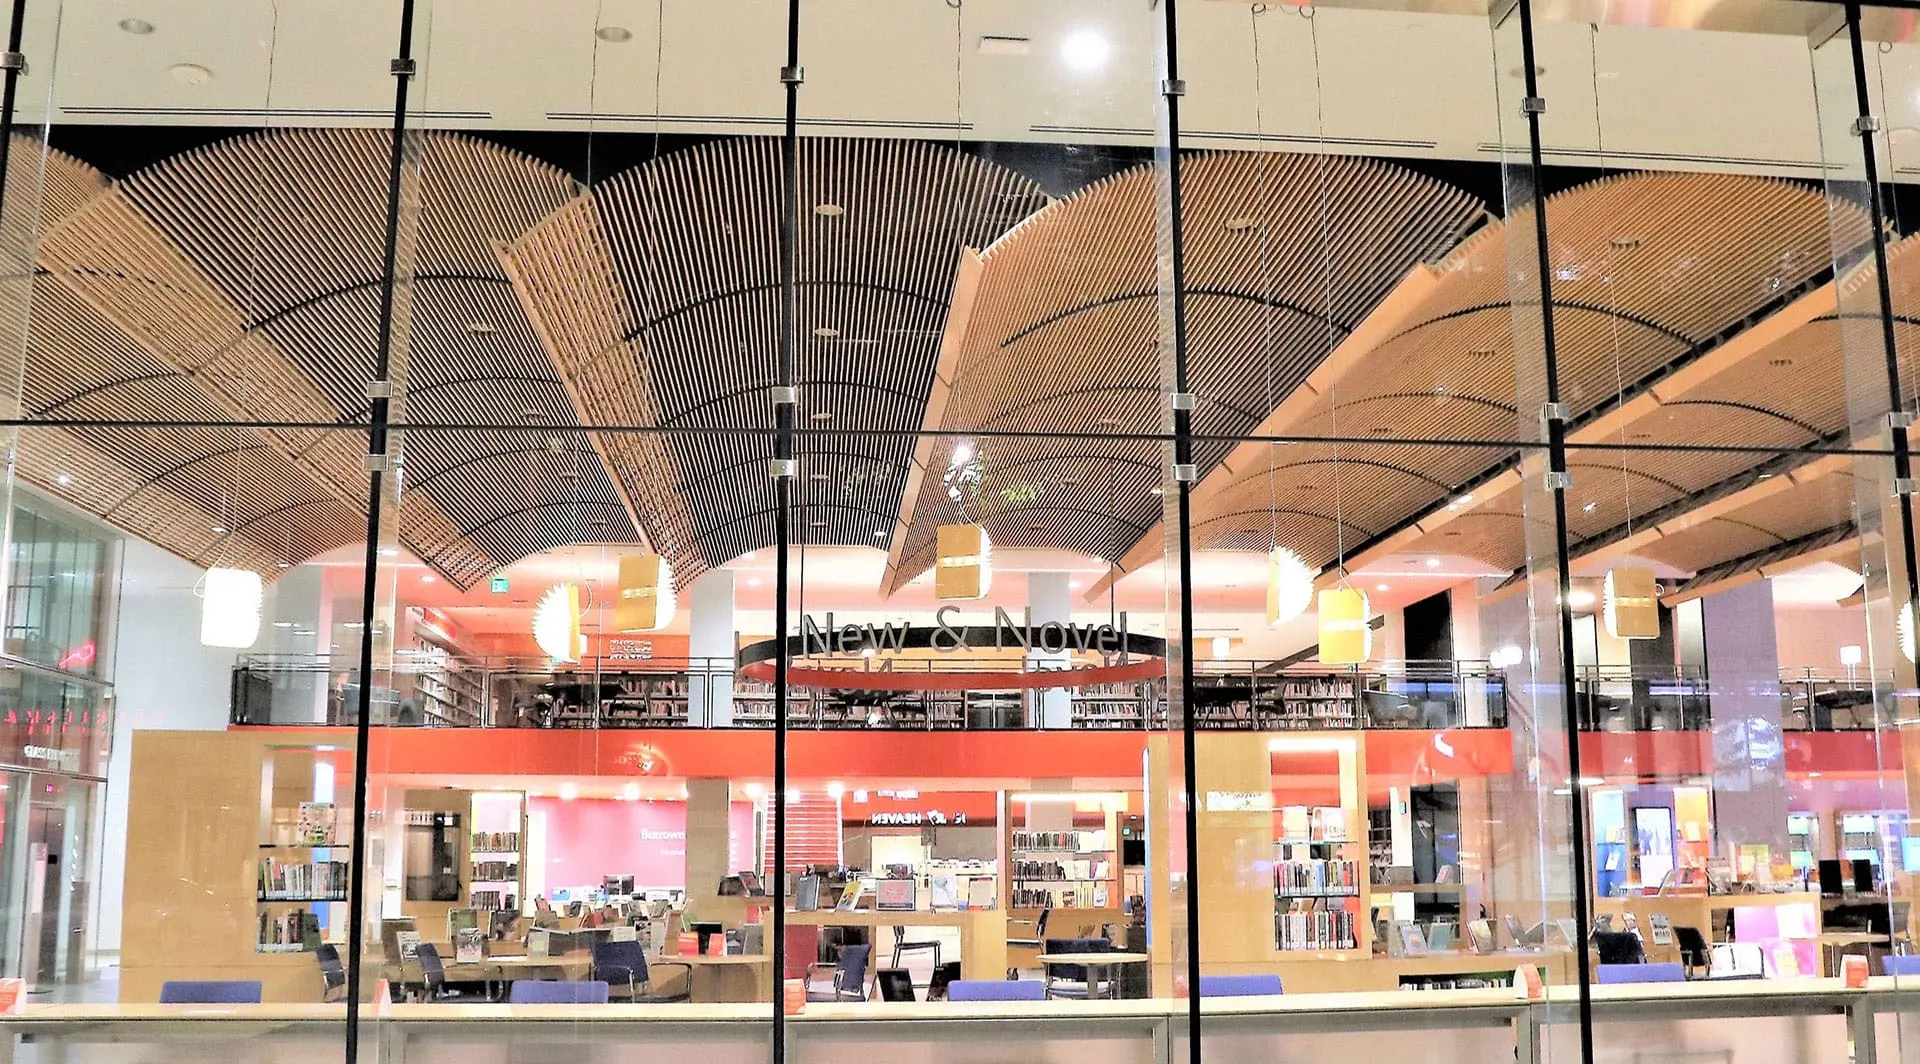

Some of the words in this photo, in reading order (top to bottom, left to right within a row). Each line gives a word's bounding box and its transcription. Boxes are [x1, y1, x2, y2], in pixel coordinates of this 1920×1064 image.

[803, 612, 911, 658] New
[930, 605, 973, 654] &
[995, 606, 1128, 657] Novel
